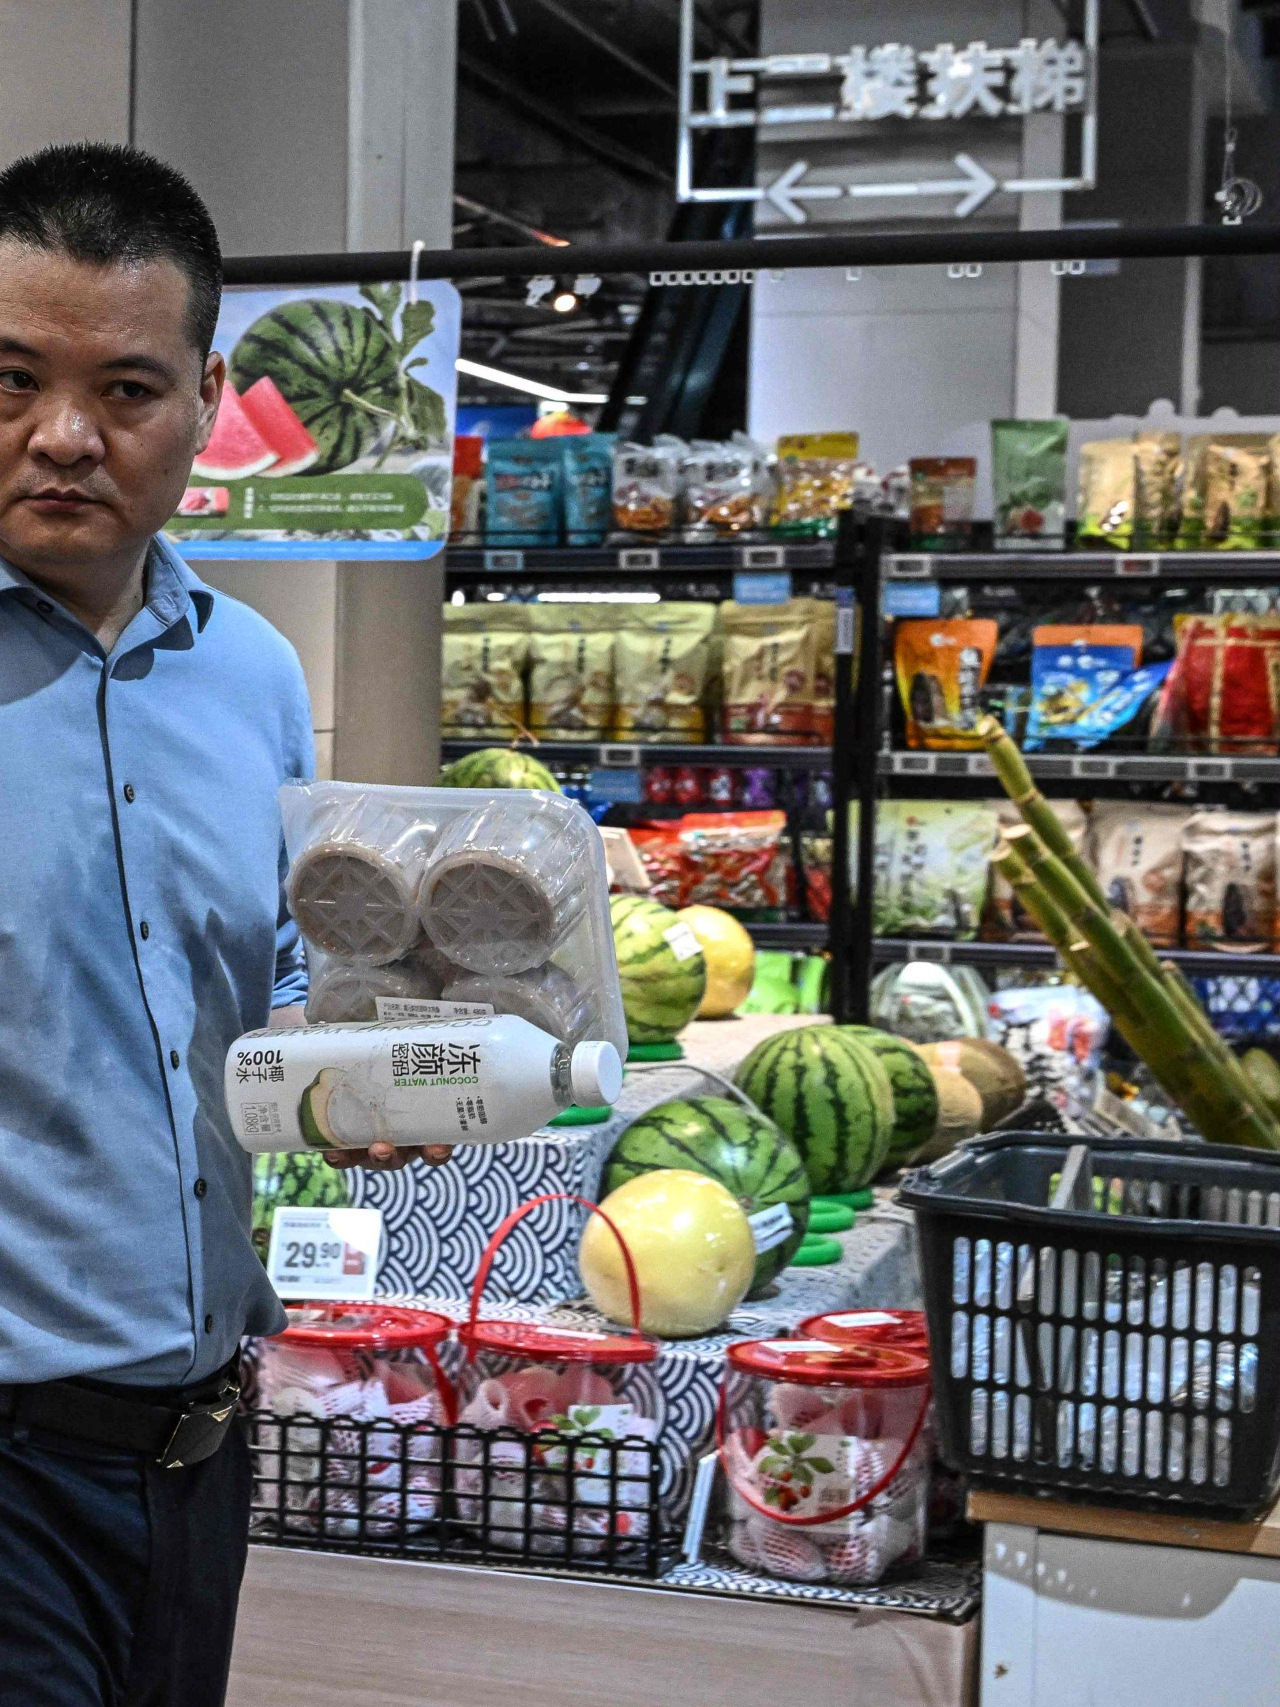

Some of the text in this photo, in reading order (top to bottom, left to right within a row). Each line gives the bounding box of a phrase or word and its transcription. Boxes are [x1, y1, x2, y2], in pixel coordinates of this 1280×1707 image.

[708, 39, 1085, 119] 上二楼扶梯
[237, 1049, 283, 1066] 100%
[236, 1065, 284, 1084] 椰子水
[393, 1075, 479, 1087] COCONUT WATER
